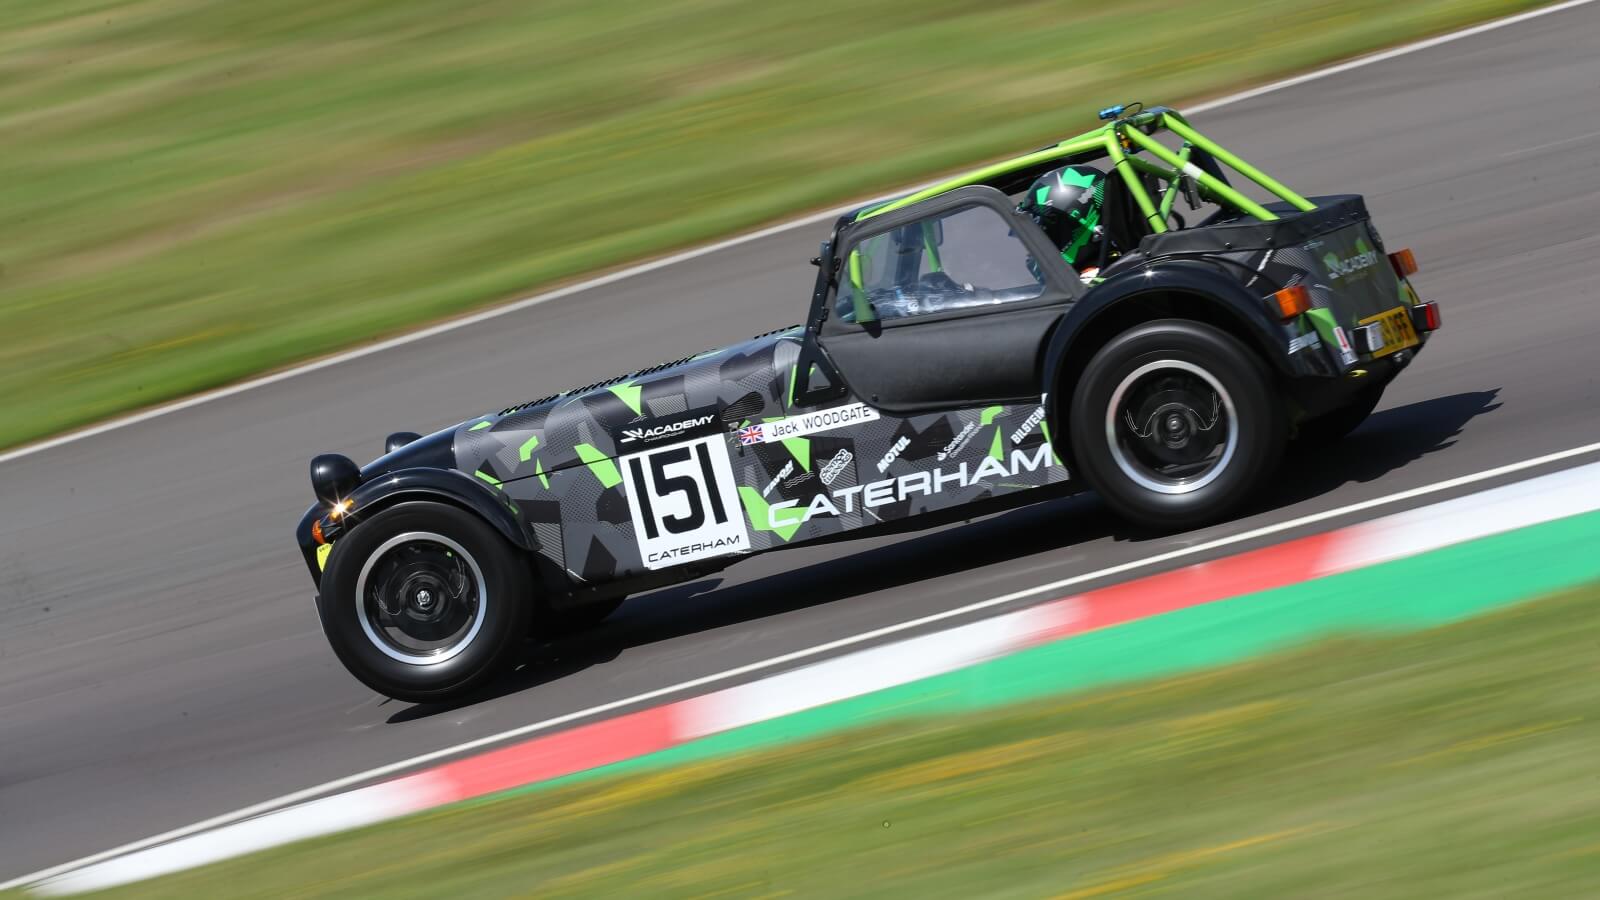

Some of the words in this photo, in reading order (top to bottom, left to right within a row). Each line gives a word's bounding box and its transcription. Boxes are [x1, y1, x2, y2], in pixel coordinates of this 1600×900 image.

[644, 415, 715, 438] ACADEMY
[772, 421, 798, 437] Jack
[803, 406, 871, 430] WOODGATE
[944, 421, 976, 454] Santander
[1010, 406, 1046, 445] BILSTEIN
[876, 435, 911, 473] MOTUL
[628, 441, 729, 540] 151
[767, 442, 1052, 529] CATERHAM
[648, 535, 740, 563] CATERHAM
